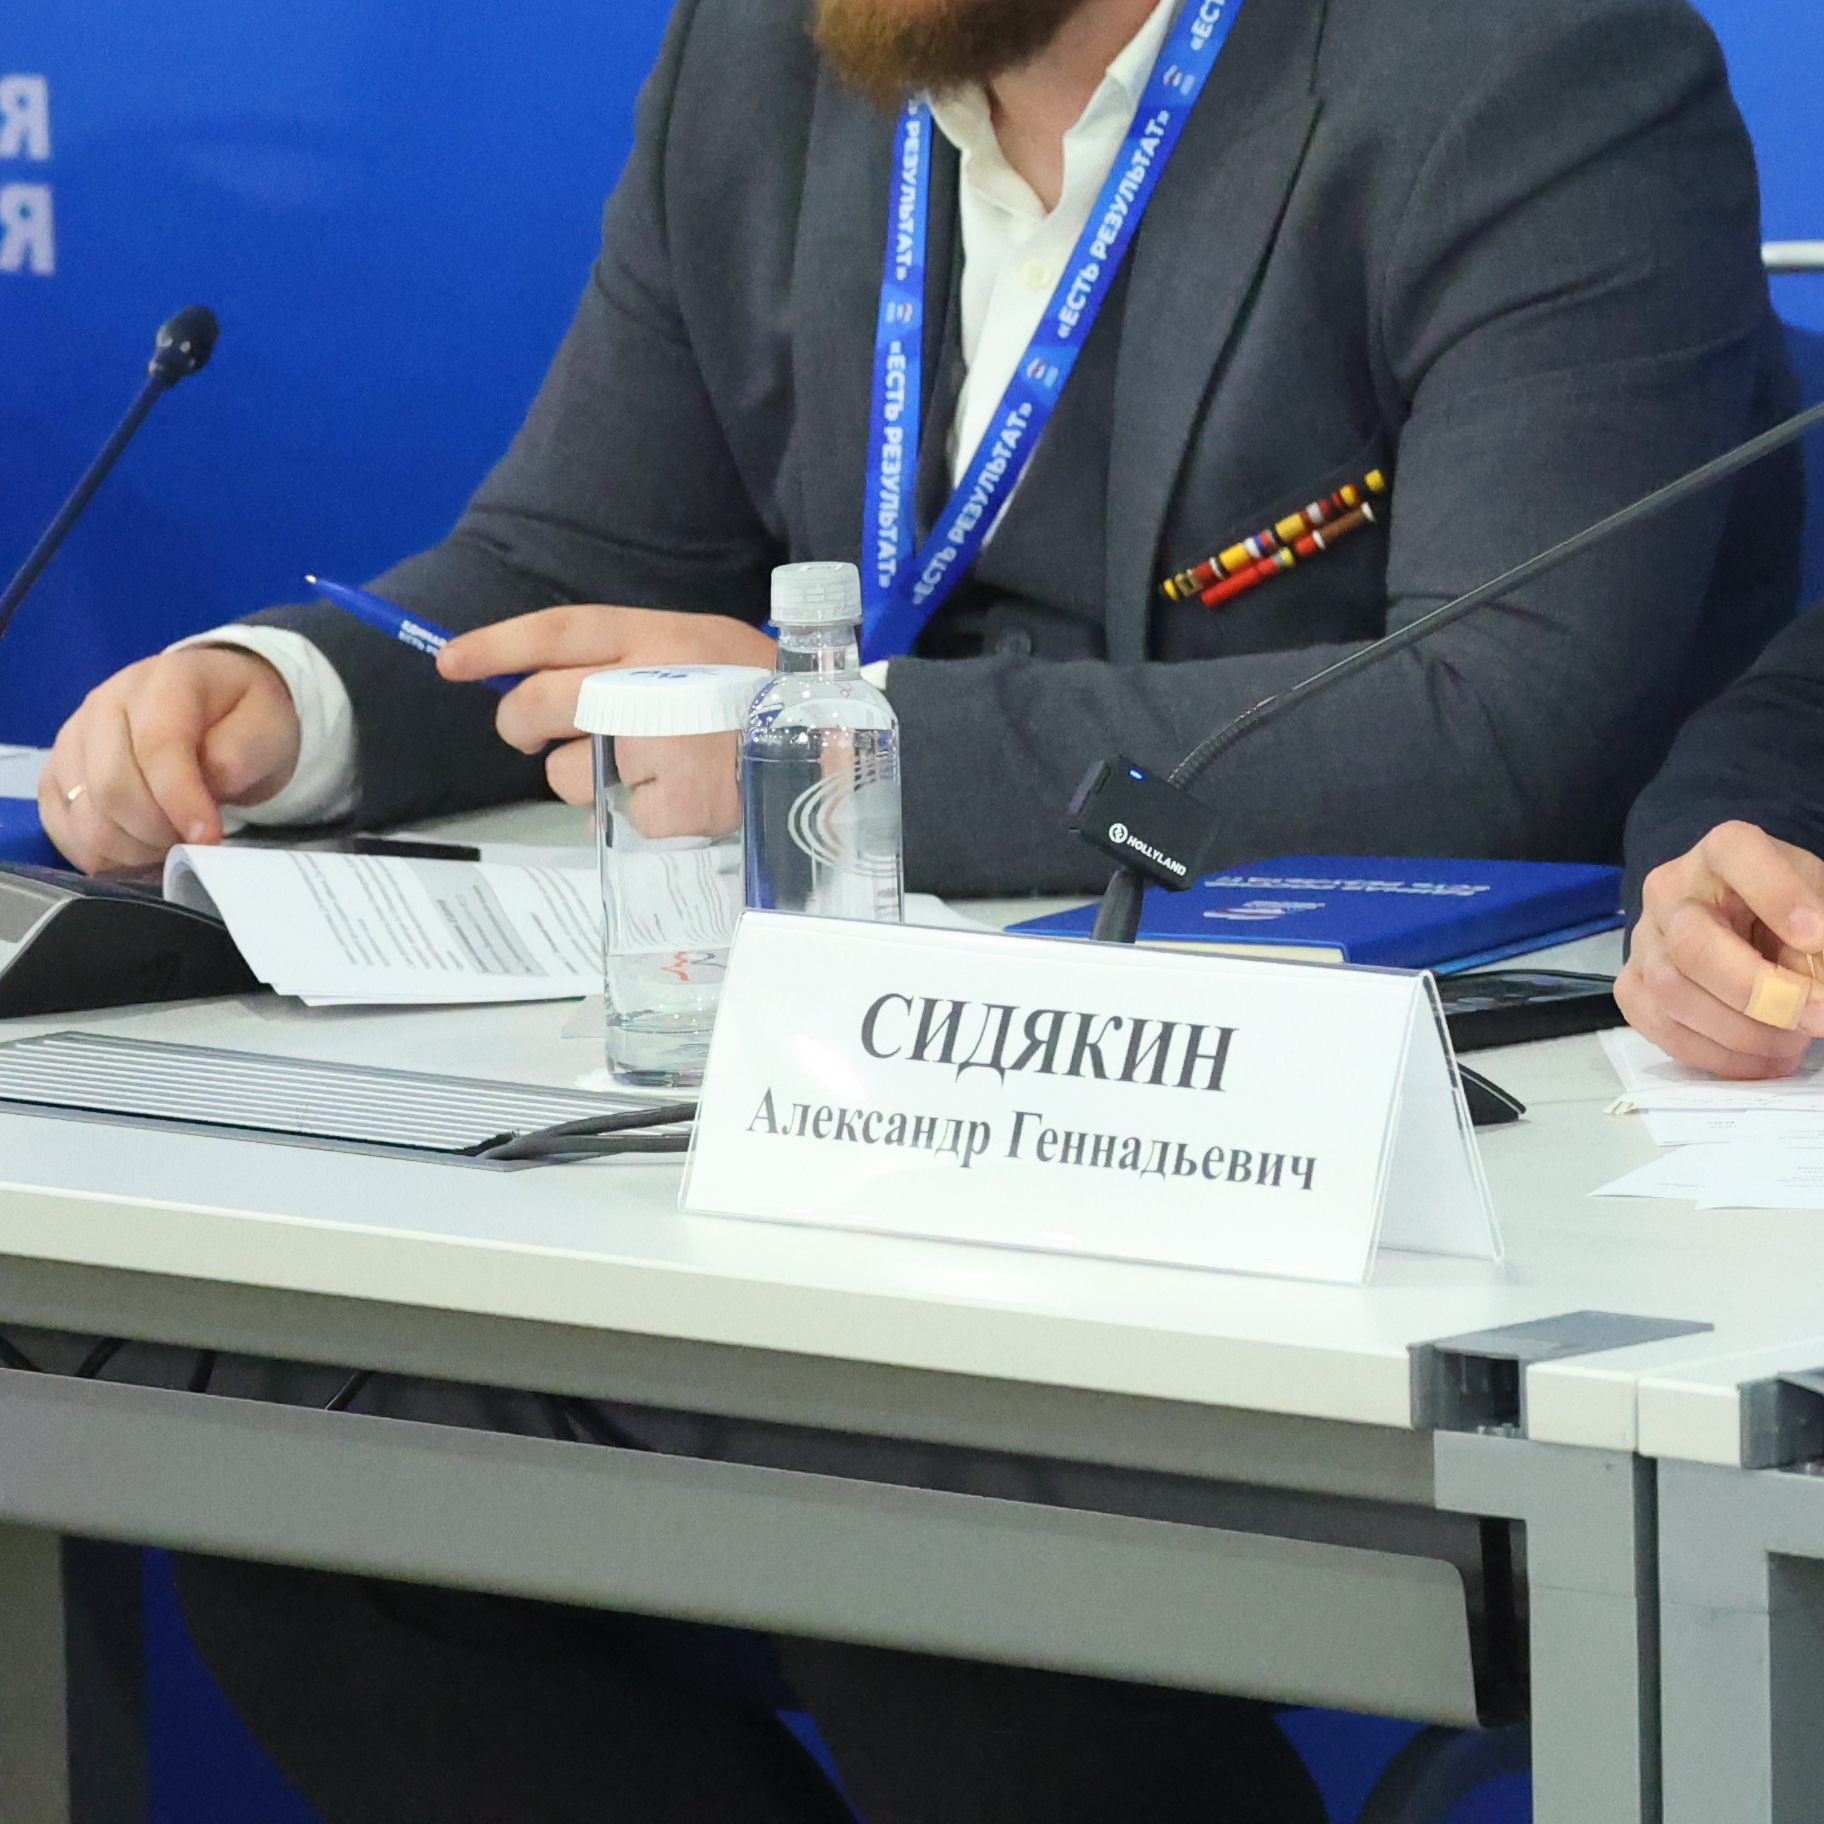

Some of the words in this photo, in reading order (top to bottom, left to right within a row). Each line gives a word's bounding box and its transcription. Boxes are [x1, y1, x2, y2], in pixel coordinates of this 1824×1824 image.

[1126, 835, 1188, 877] HOLLYLAND
[860, 992, 1240, 1093] СИДЯКИН
[746, 1086, 991, 1169] Александр
[1003, 1107, 1318, 1191] Геннадьевич
